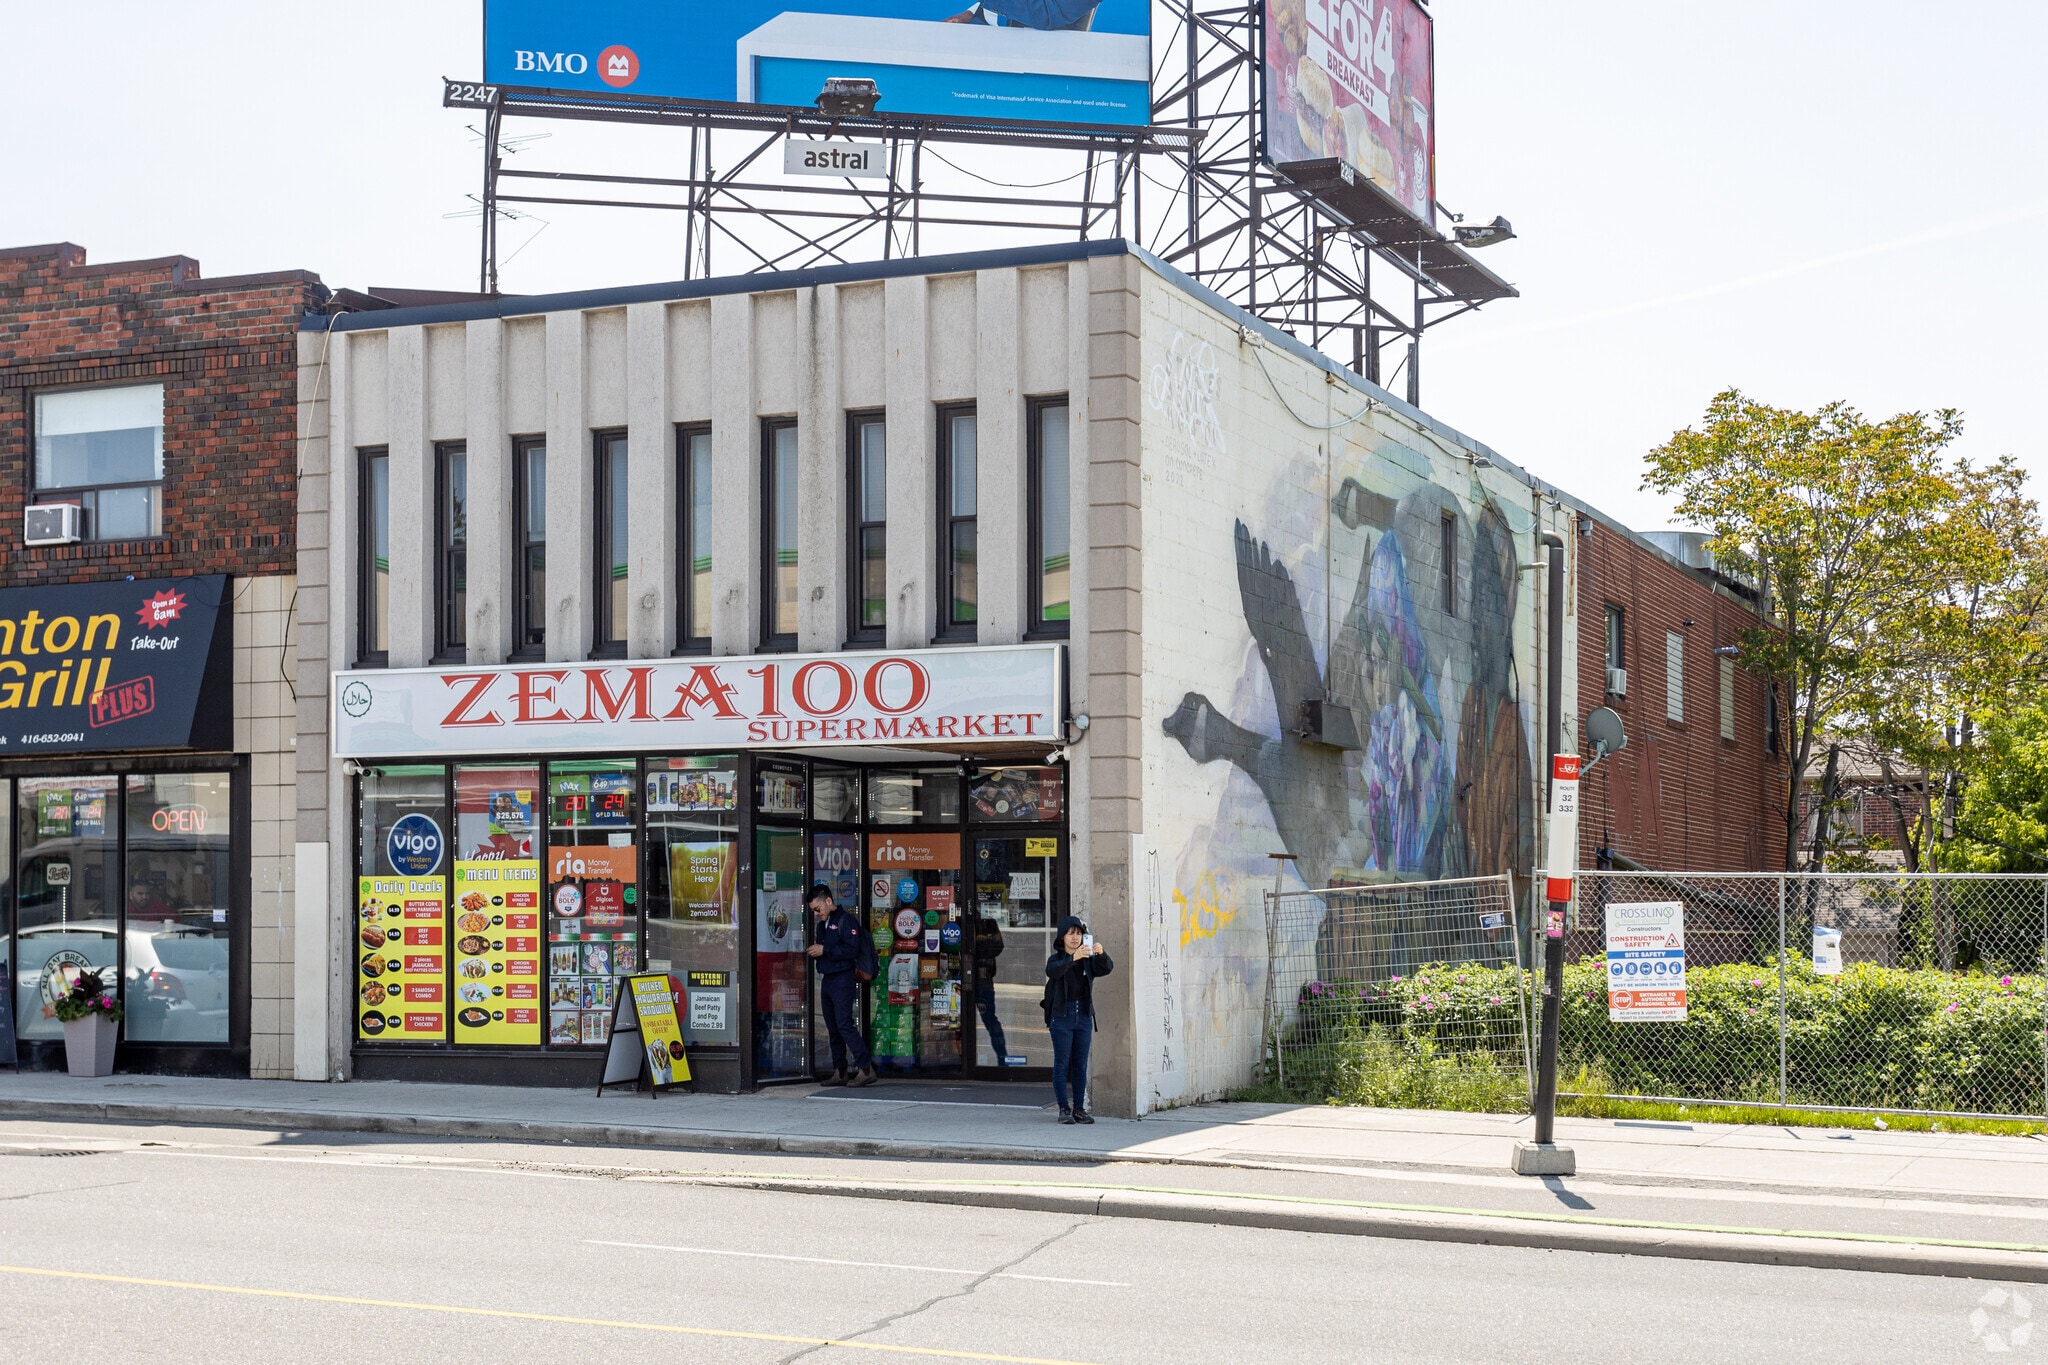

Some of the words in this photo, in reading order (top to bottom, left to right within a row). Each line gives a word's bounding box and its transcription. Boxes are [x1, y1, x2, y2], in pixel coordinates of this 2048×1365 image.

[1328, 0, 1374, 80] FOR
[514, 50, 588, 74] BMO
[1327, 50, 1375, 107] BREAKFAST
[450, 84, 498, 103] 2247
[804, 148, 869, 170] astral
[1165, 469, 1185, 488] 2022
[151, 600, 168, 611] Open
[168, 597, 177, 606] at
[153, 608, 176, 621] 6am
[131, 635, 180, 650] Take-Out
[440, 657, 931, 729] ZEMA100
[96, 683, 148, 722] PLUS
[746, 713, 1044, 742] SUPERMARKET
[21, 733, 84, 744] 416-652-0941
[560, 781, 580, 792] MAX
[565, 795, 585, 811] 20
[590, 795, 595, 803] $
[604, 794, 624, 810] 24
[1043, 800, 1057, 808] Meat
[1562, 794, 1573, 802] 32
[1558, 804, 1574, 813] 332
[152, 809, 206, 832] OPEN
[496, 811, 524, 820] $25,575
[393, 830, 438, 855] vigo
[876, 839, 906, 861] ria
[908, 846, 931, 855] Money
[398, 855, 406, 863] by
[556, 851, 586, 875] ria
[587, 859, 610, 867] Money
[690, 855, 718, 866] Spring
[816, 839, 852, 877] vigo
[410, 862, 428, 870] Union
[587, 867, 613, 875] Transfer
[690, 865, 718, 874] Starts
[466, 868, 499, 881] MENU
[503, 868, 538, 880] ITEMS
[694, 875, 714, 883] Here
[375, 880, 405, 896] Daily
[409, 880, 443, 894] Deals
[942, 928, 961, 937] vigo
[47, 955, 61, 970] DAY
[923, 965, 937, 973] SKIP
[42, 972, 50, 990] ALL
[691, 972, 721, 980] WESTERN
[700, 978, 721, 986] UNION
[637, 981, 663, 992] CHICKEN
[640, 1004, 672, 1016] SANDWICH
[707, 1004, 721, 1012] Patty
[708, 1013, 718, 1021] Pop
[711, 1021, 723, 1029] 2.99
